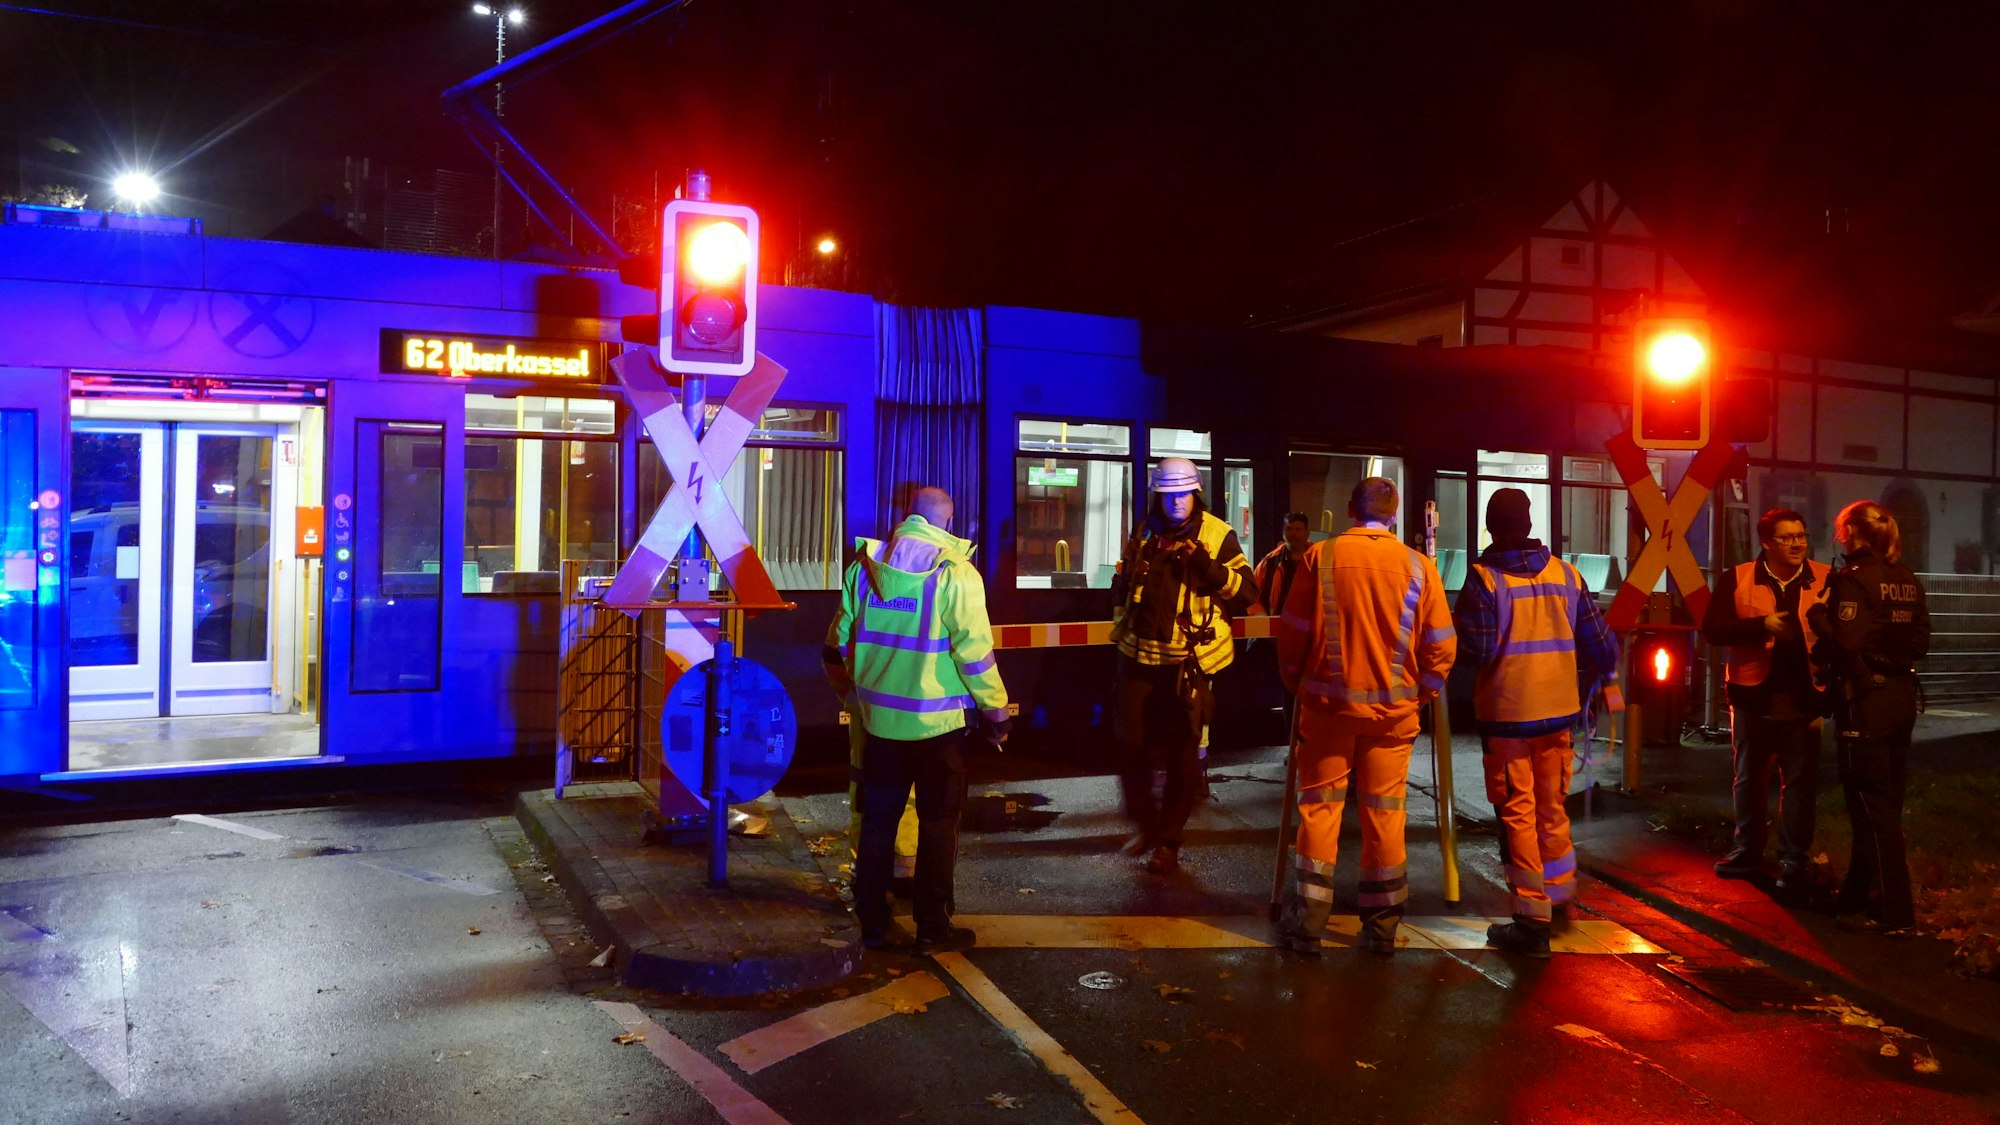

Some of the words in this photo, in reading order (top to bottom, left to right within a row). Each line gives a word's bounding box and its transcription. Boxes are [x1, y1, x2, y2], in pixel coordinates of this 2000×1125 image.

[406, 338, 444, 369] 62
[449, 341, 590, 376] Oberkassel
[1880, 583, 1918, 602] POLIZEI
[1892, 610, 1913, 622] NRW
